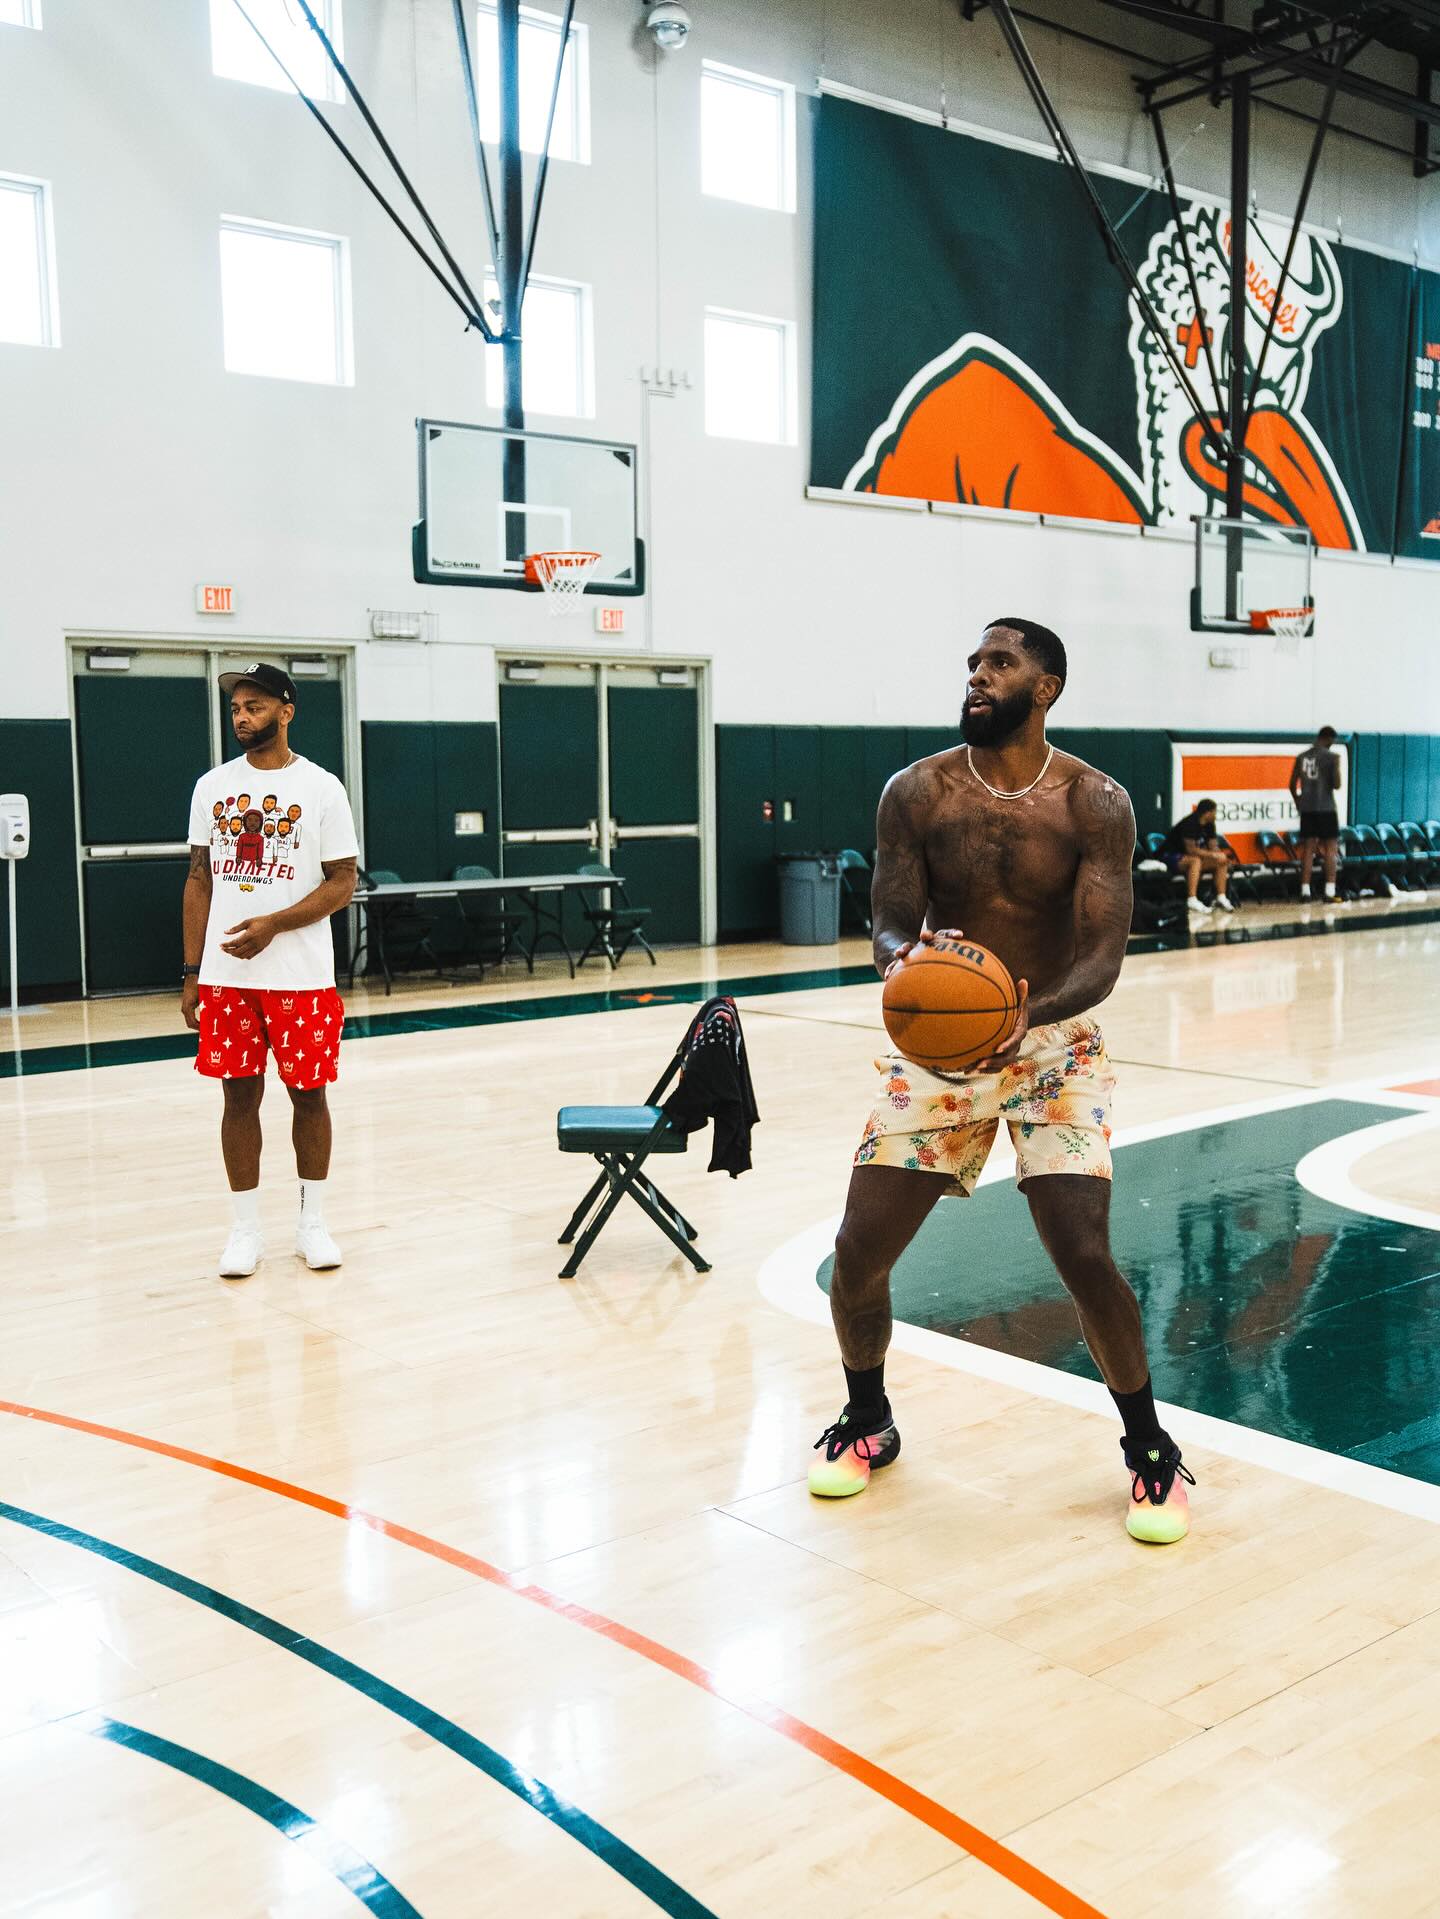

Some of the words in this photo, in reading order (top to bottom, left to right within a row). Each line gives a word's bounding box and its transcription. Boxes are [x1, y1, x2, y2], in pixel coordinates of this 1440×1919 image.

[204, 587, 232, 610] EXIT
[603, 609, 624, 629] EXIT
[222, 874, 274, 885] UNDERDAWGS
